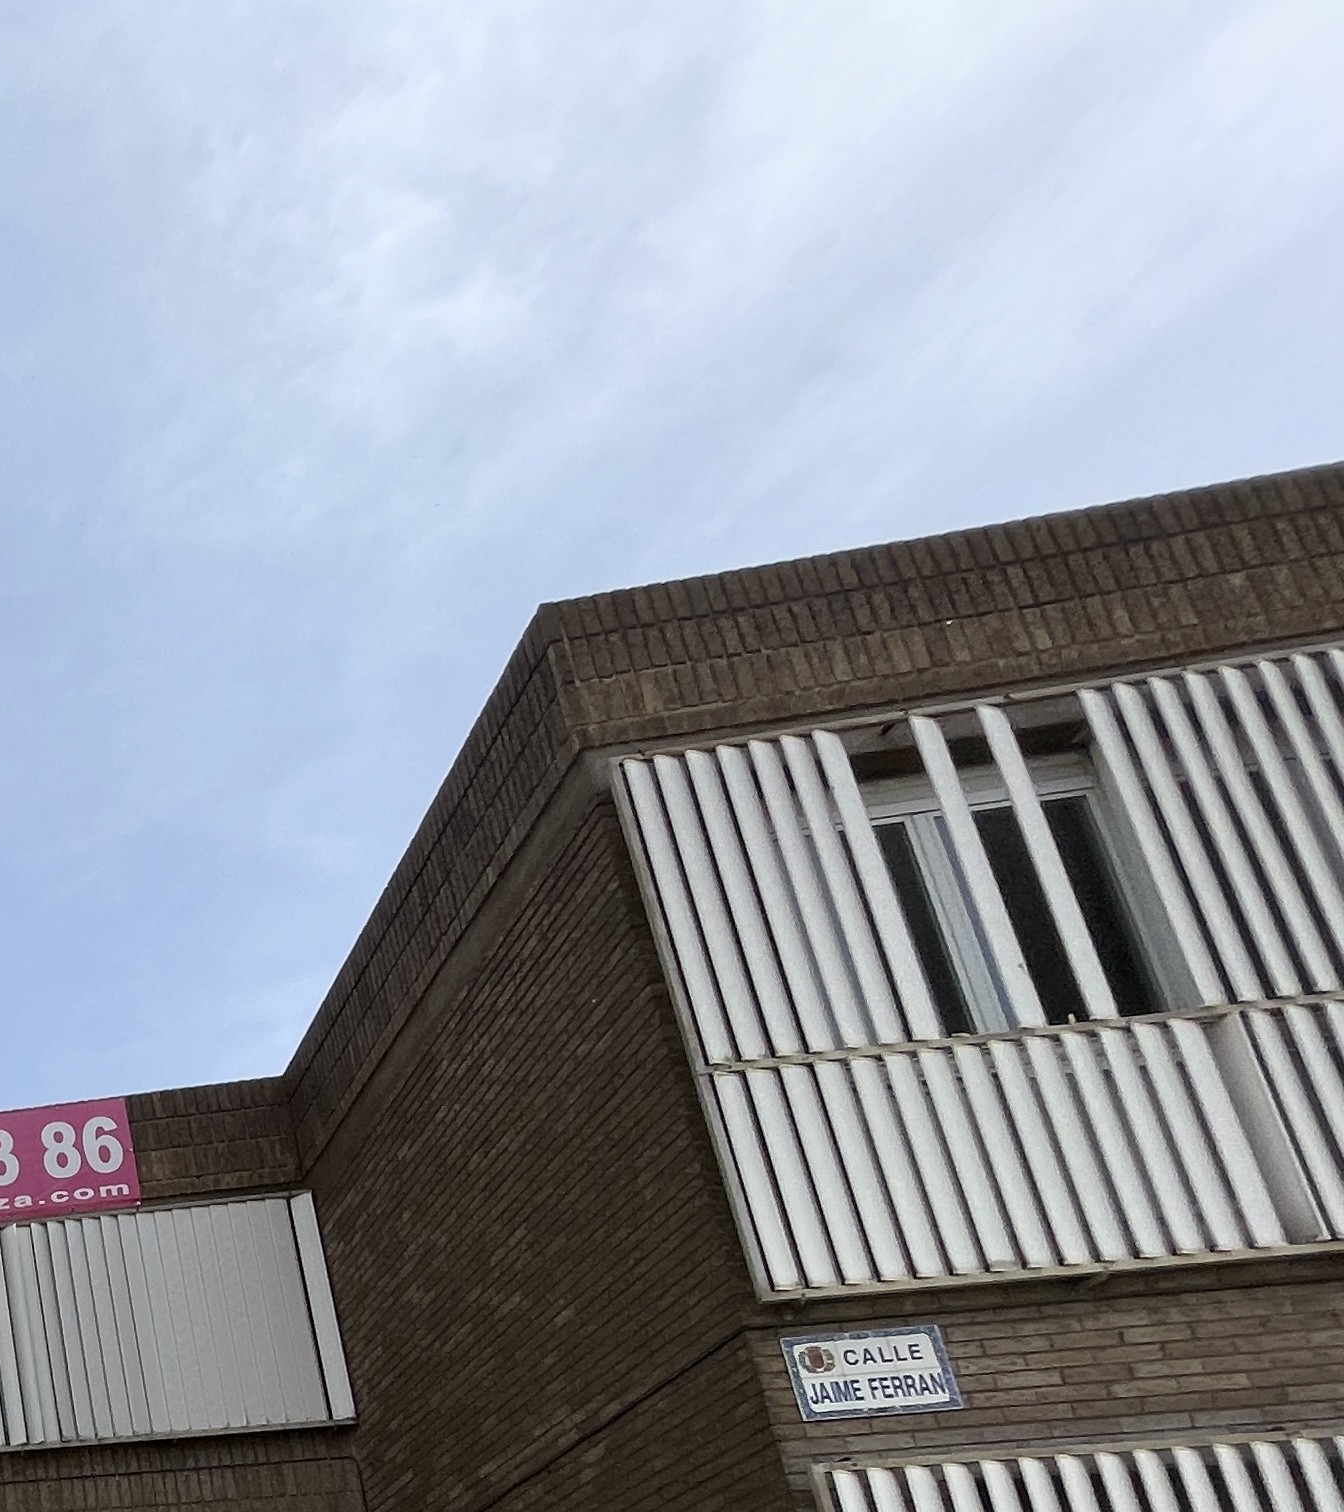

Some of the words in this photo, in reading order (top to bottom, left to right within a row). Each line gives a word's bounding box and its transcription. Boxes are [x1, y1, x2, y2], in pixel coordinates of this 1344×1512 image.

[41, 1115, 119, 1179] 86
[843, 1343, 924, 1366] CALLE
[810, 1379, 864, 1405] JAIME
[867, 1372, 948, 1400] FERRAN
